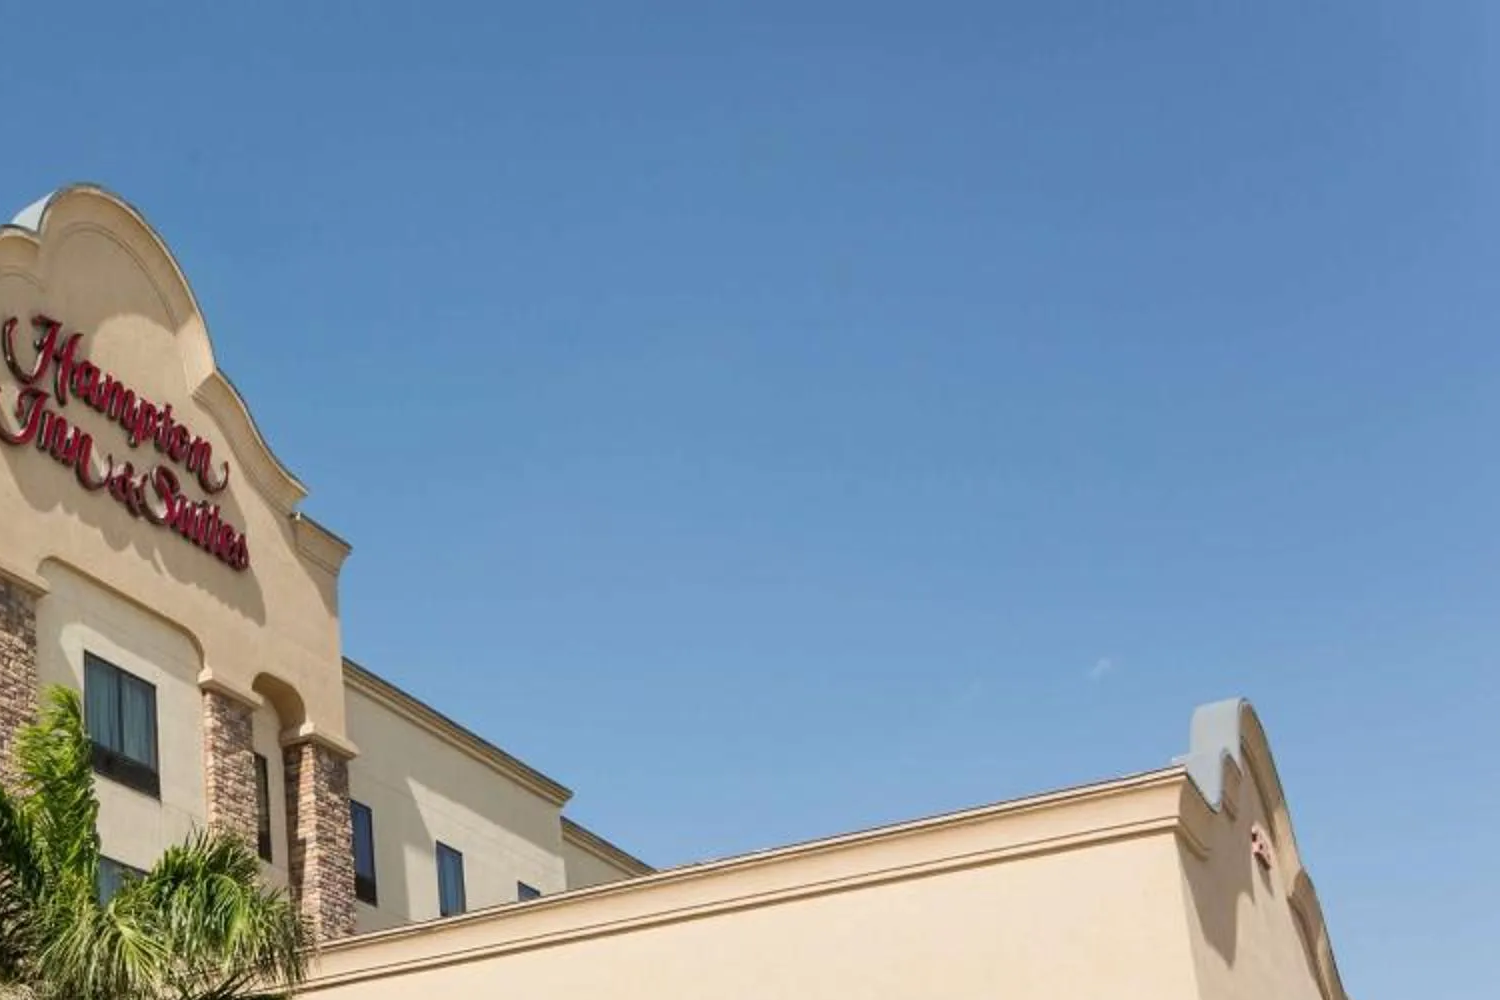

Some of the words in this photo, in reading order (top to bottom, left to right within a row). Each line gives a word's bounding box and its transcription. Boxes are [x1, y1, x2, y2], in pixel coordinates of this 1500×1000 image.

[1, 314, 229, 494] Hampton
[108, 461, 145, 518] &
[138, 465, 249, 572] Suites
